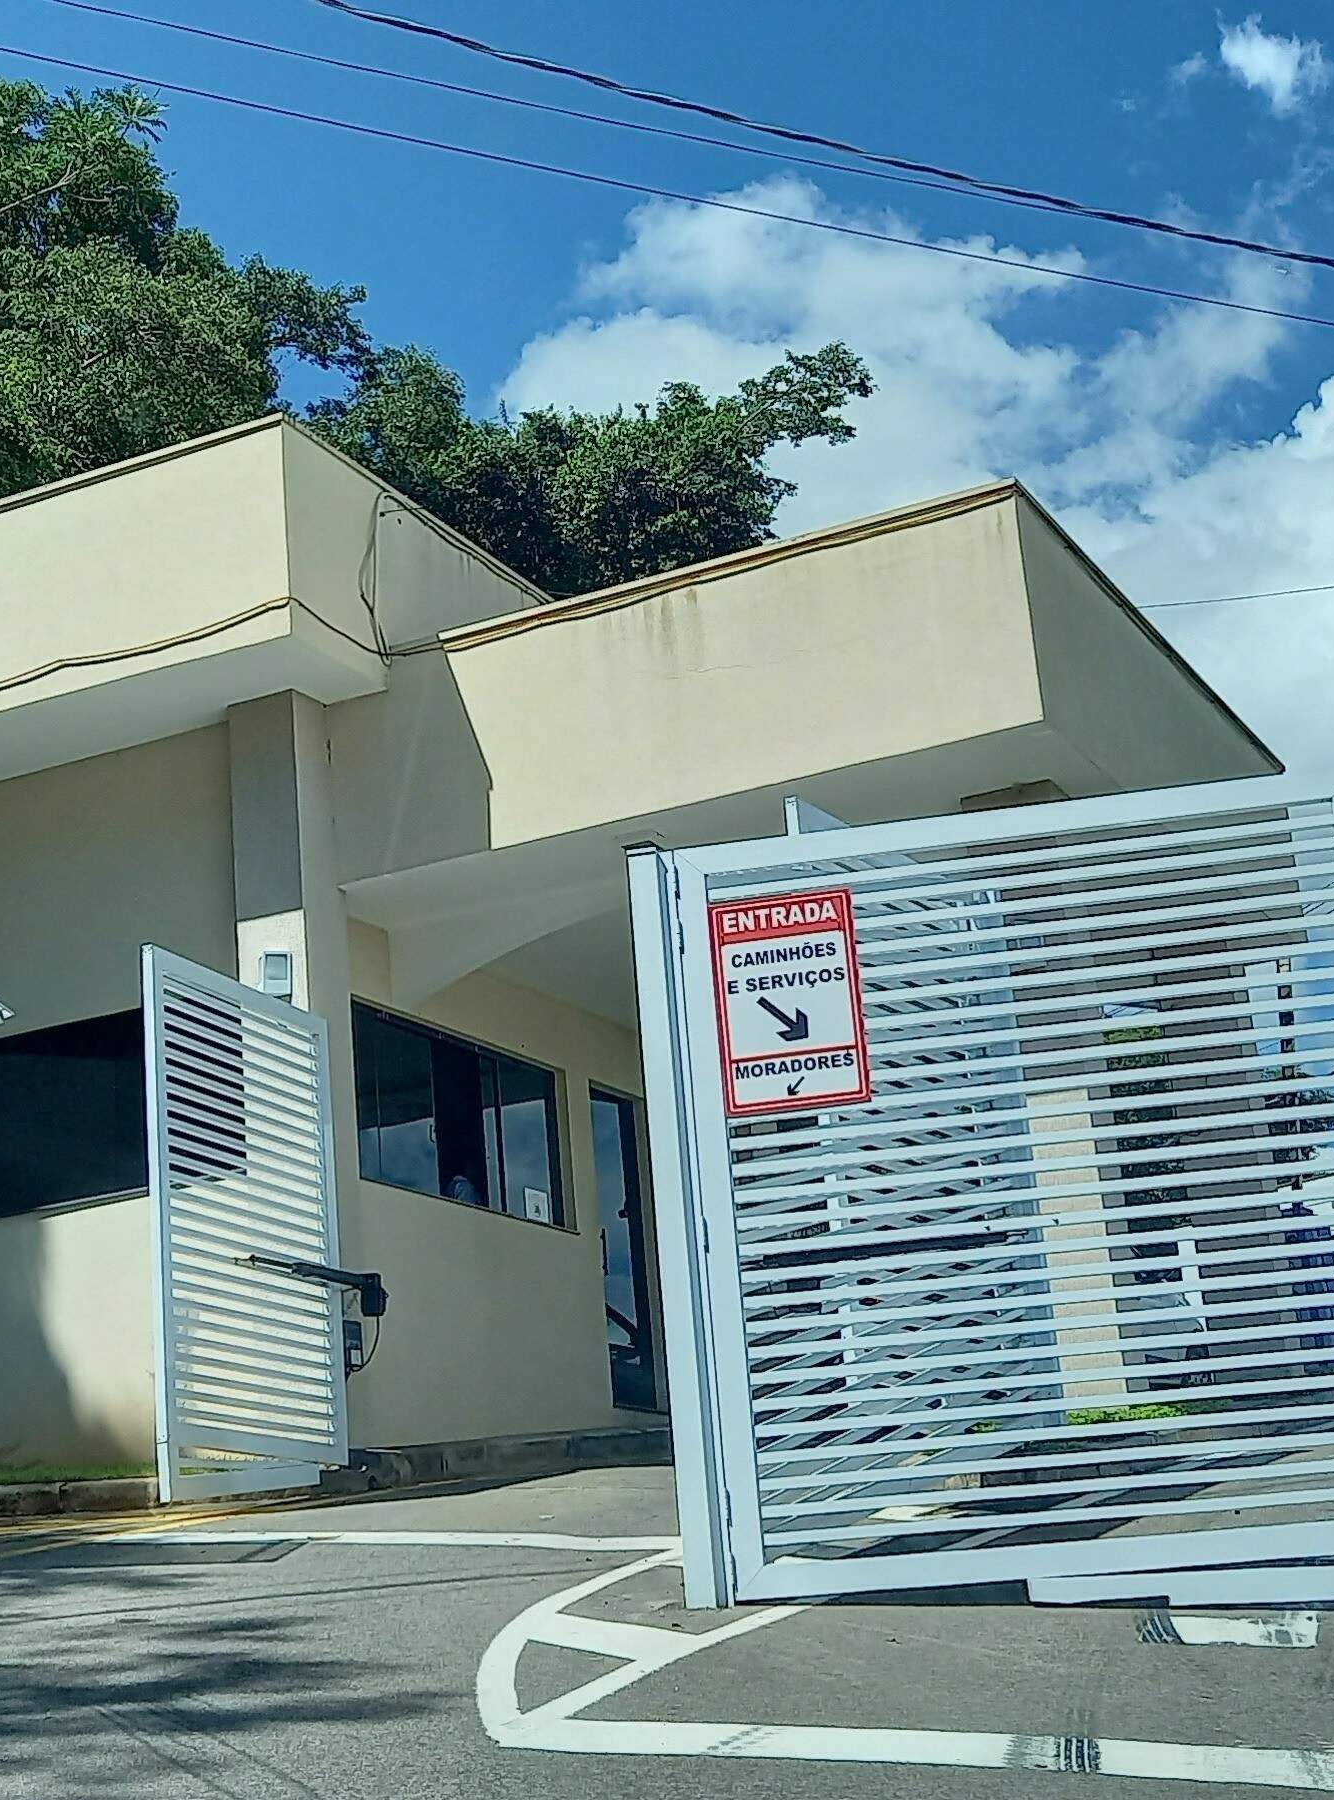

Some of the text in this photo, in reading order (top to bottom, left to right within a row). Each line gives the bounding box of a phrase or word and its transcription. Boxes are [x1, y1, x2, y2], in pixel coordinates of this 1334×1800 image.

[722, 900, 839, 934] ENTRADA
[731, 941, 837, 968] CAMINHÕES
[727, 966, 845, 994] E SERVIÇOS
[735, 1052, 854, 1080] MORADORES
